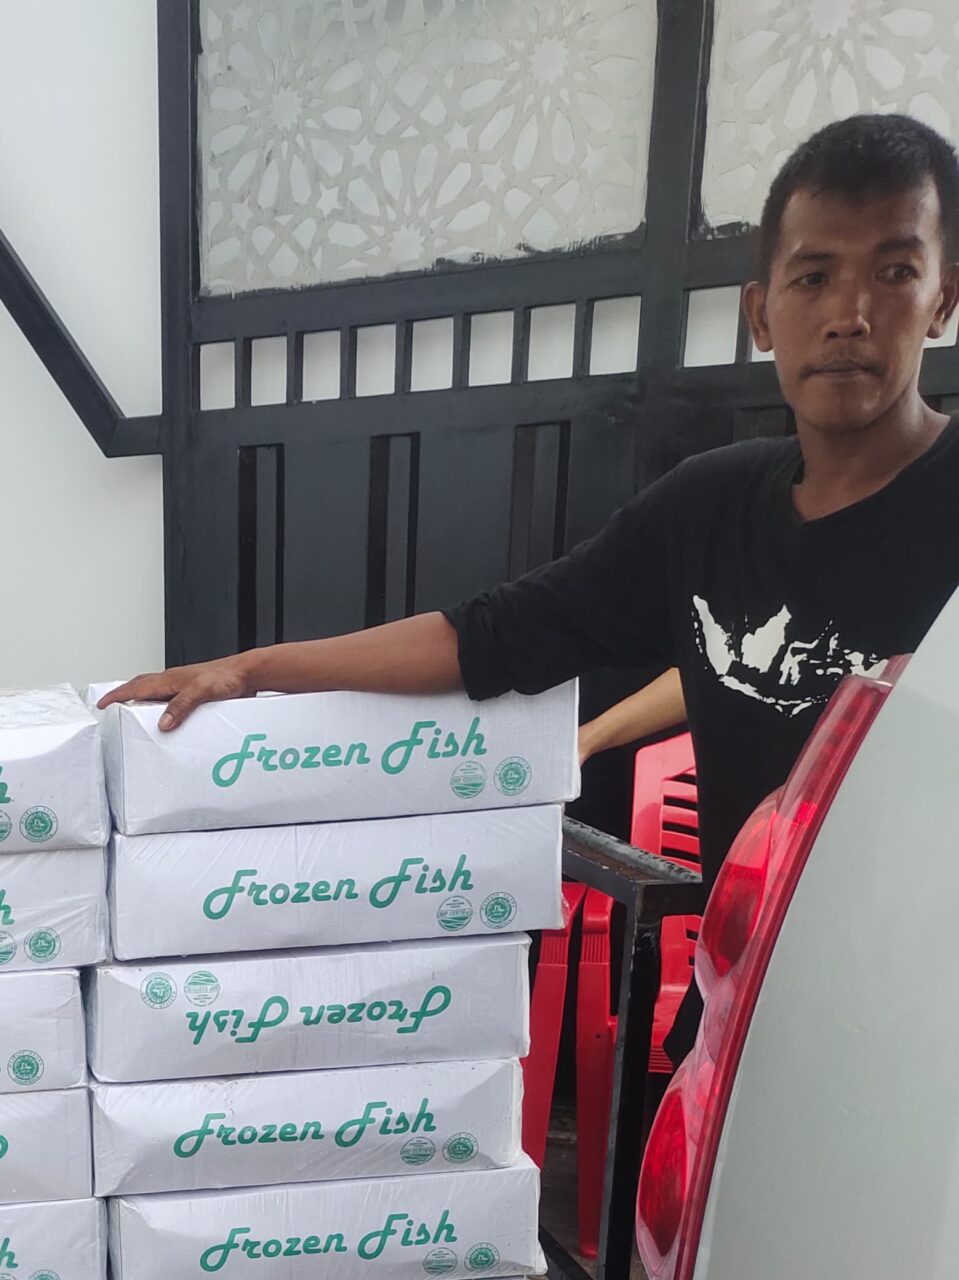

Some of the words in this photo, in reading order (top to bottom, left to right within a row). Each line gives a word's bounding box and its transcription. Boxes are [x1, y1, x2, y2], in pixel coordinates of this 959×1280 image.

[212, 733, 370, 788] Frozen
[381, 717, 487, 775] Fish
[203, 869, 359, 920] Frozen
[368, 854, 472, 909] Fish
[186, 995, 289, 1045] Fish
[300, 985, 452, 1034] Frozen
[173, 1113, 324, 1158] Frozen
[334, 1098, 436, 1148] Fish
[199, 1227, 347, 1273] Frozen
[357, 1210, 457, 1261] Fish
